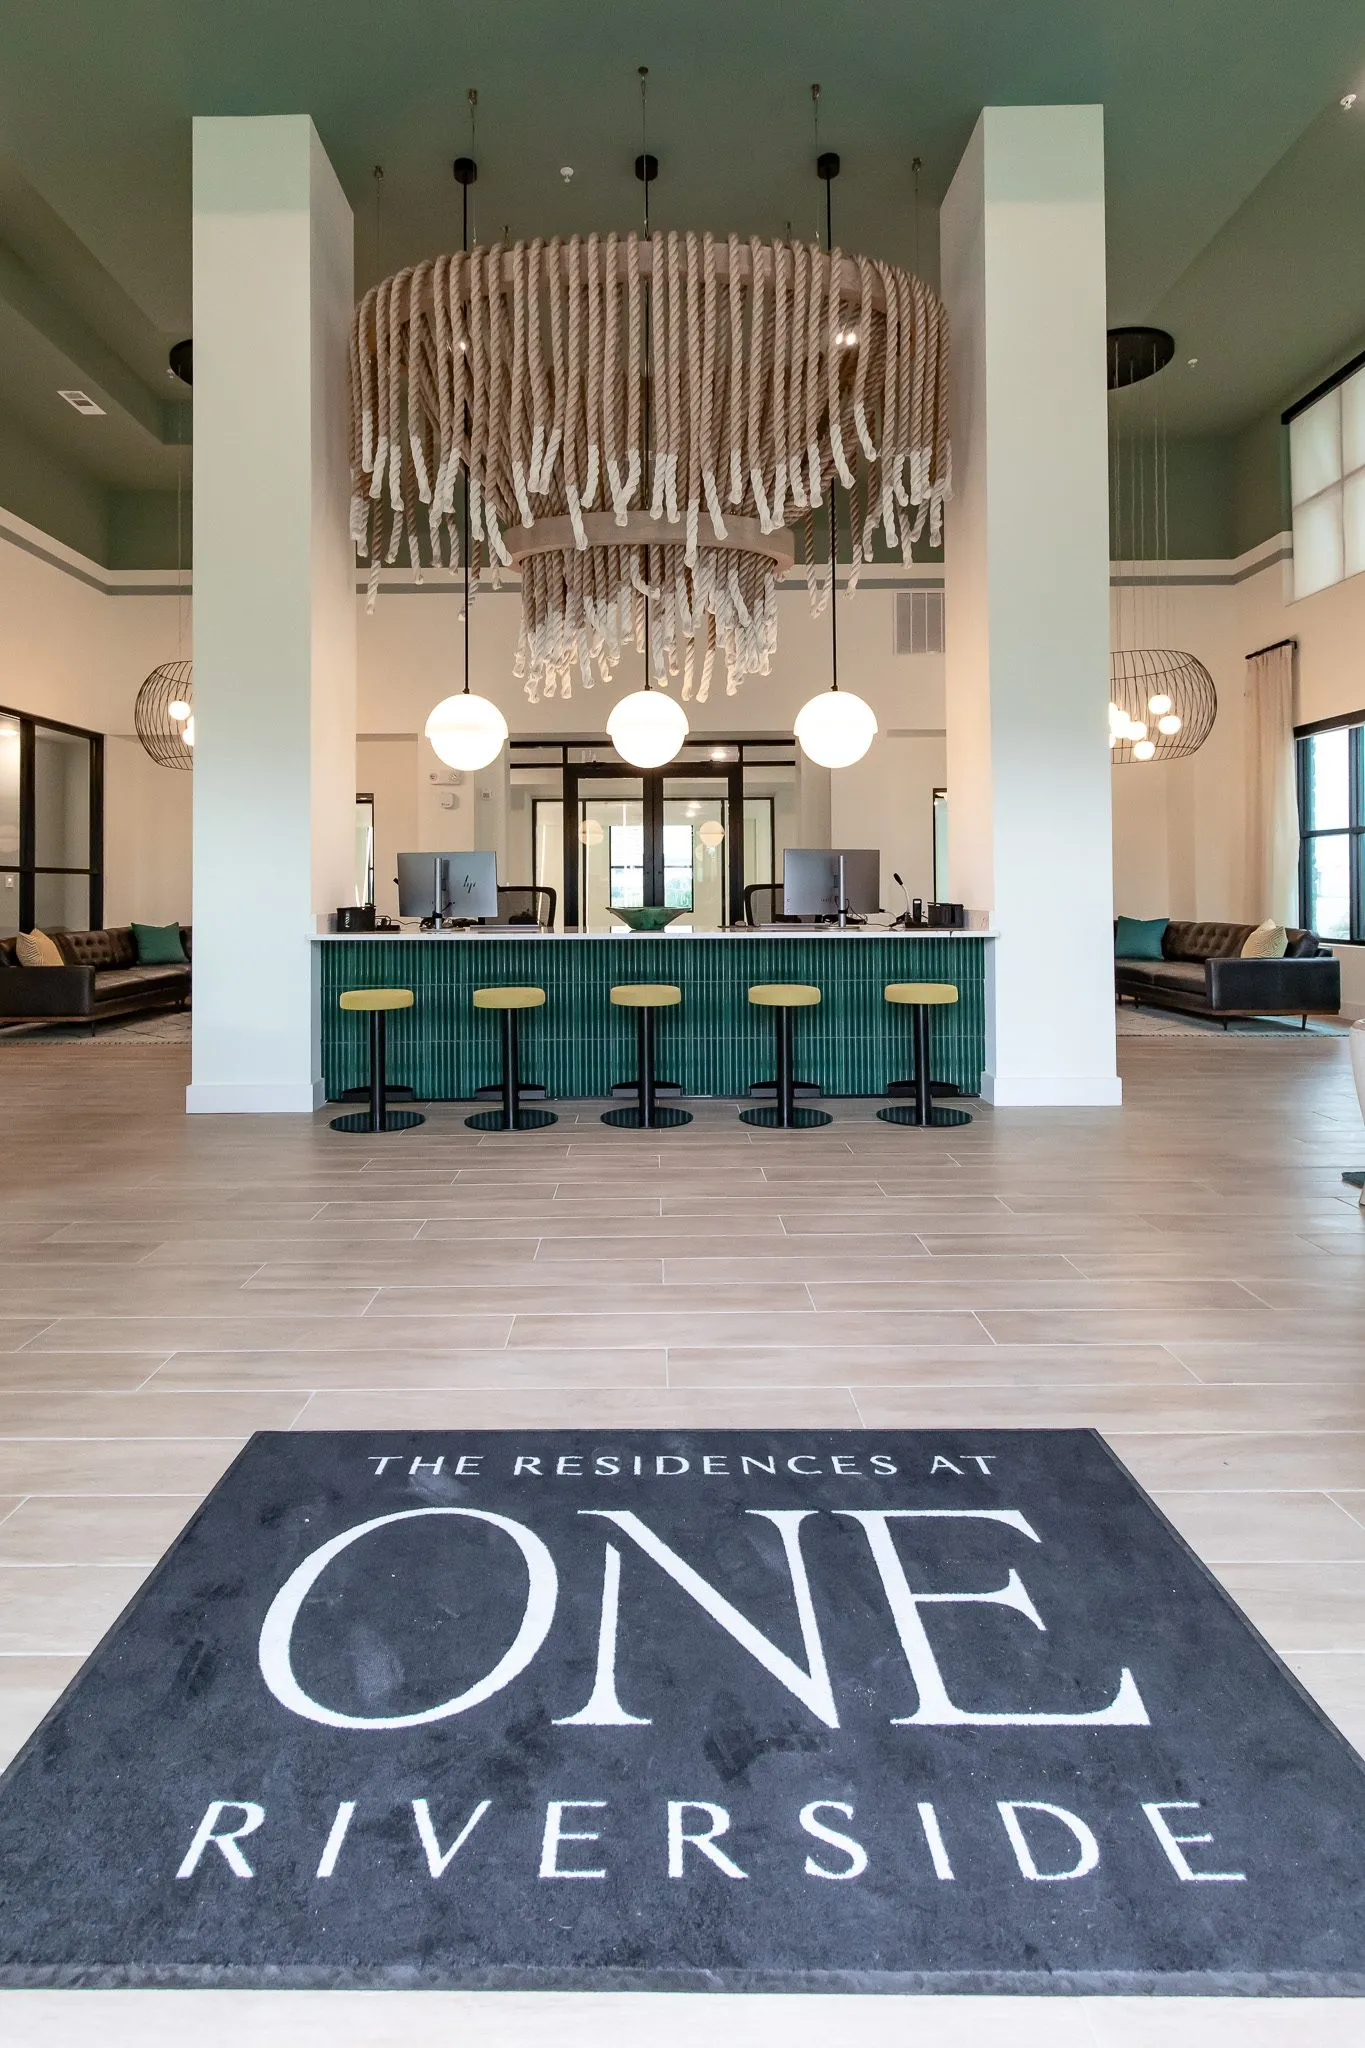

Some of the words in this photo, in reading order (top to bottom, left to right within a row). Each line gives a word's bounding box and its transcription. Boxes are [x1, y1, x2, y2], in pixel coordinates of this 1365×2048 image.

[368, 1455, 484, 1476] THE
[513, 1455, 898, 1476] RESIDENCES
[930, 1455, 997, 1476] AT
[258, 1506, 1150, 1731] ONE
[175, 1799, 1248, 1883] RIVERSIDE
